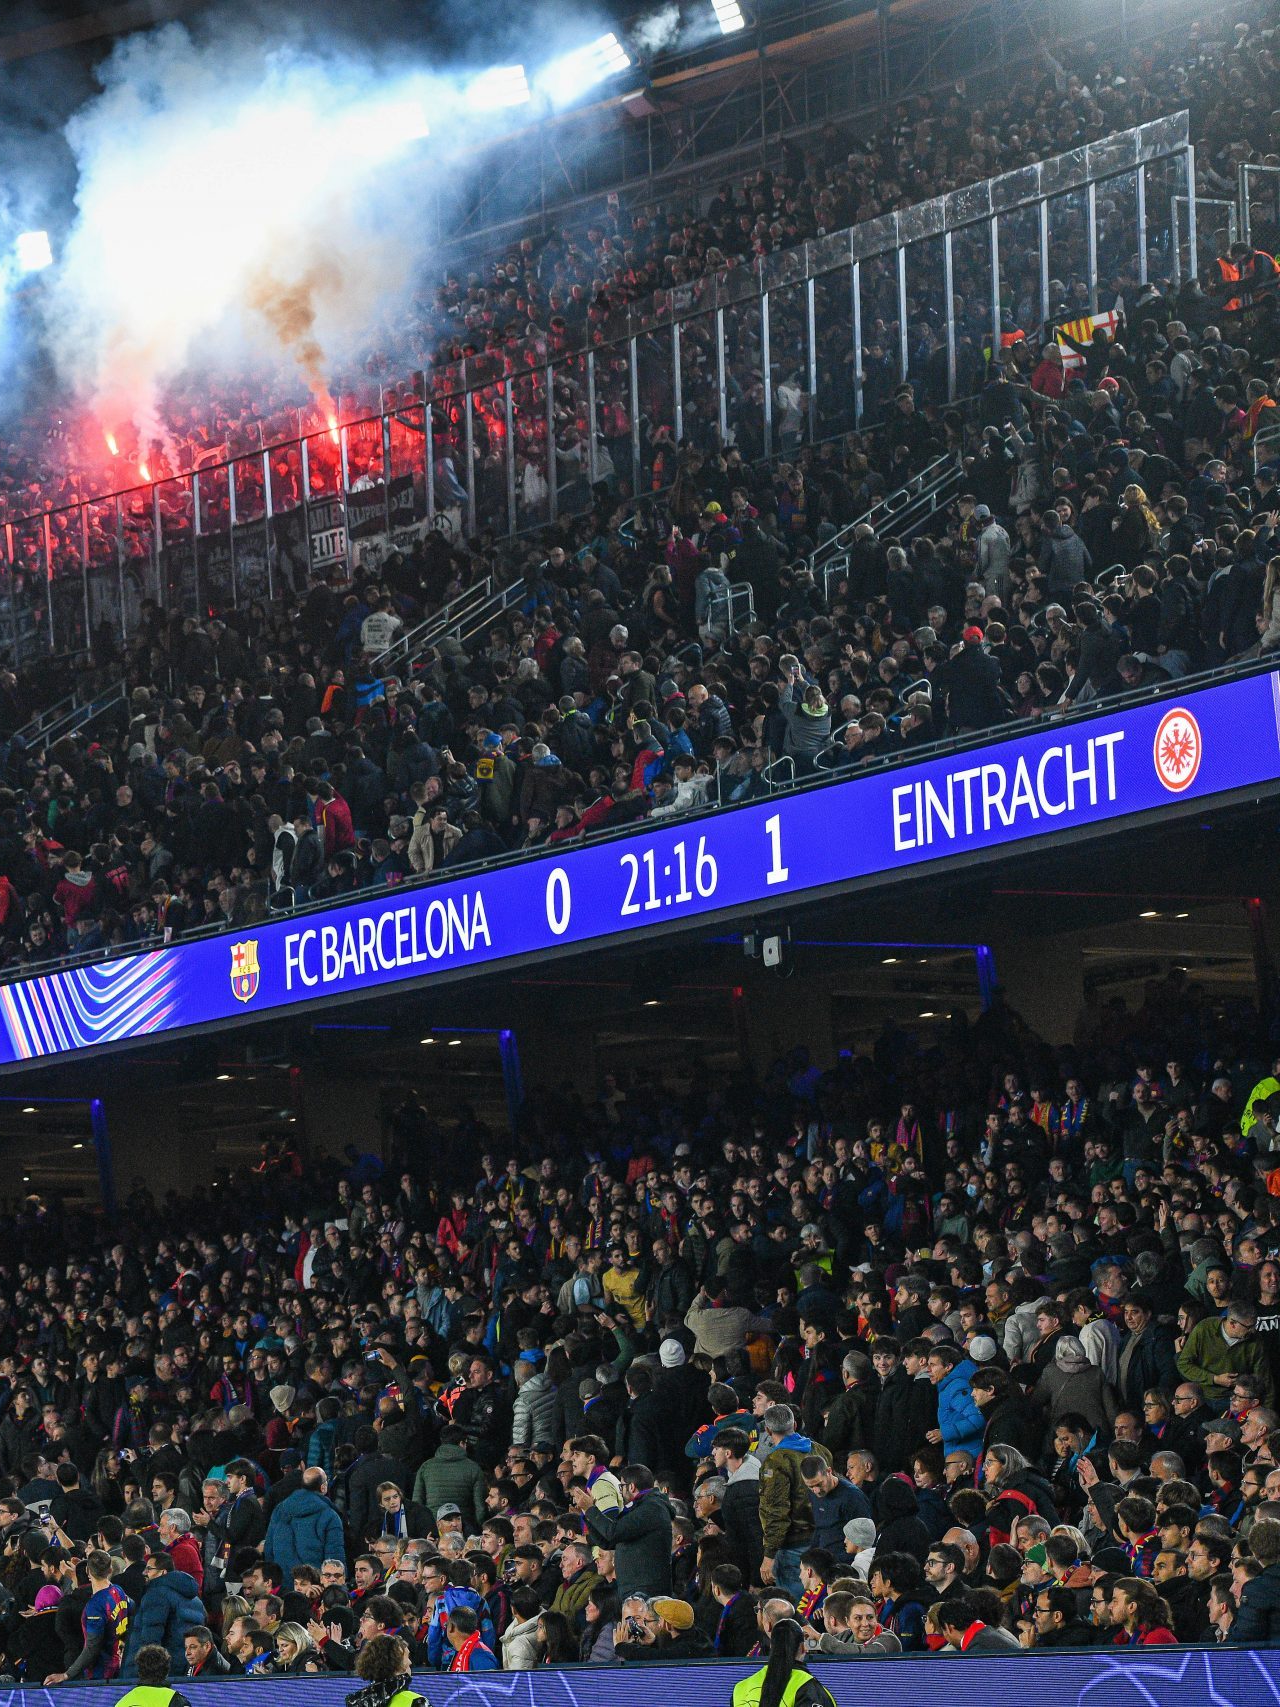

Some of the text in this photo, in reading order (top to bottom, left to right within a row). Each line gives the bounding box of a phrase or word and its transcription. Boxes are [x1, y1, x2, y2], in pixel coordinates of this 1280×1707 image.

[310, 503, 344, 532] ADLE
[312, 530, 344, 559] ELITE
[285, 731, 1125, 991] FC BARCELONA 0 21:16 1 EINTRACHT
